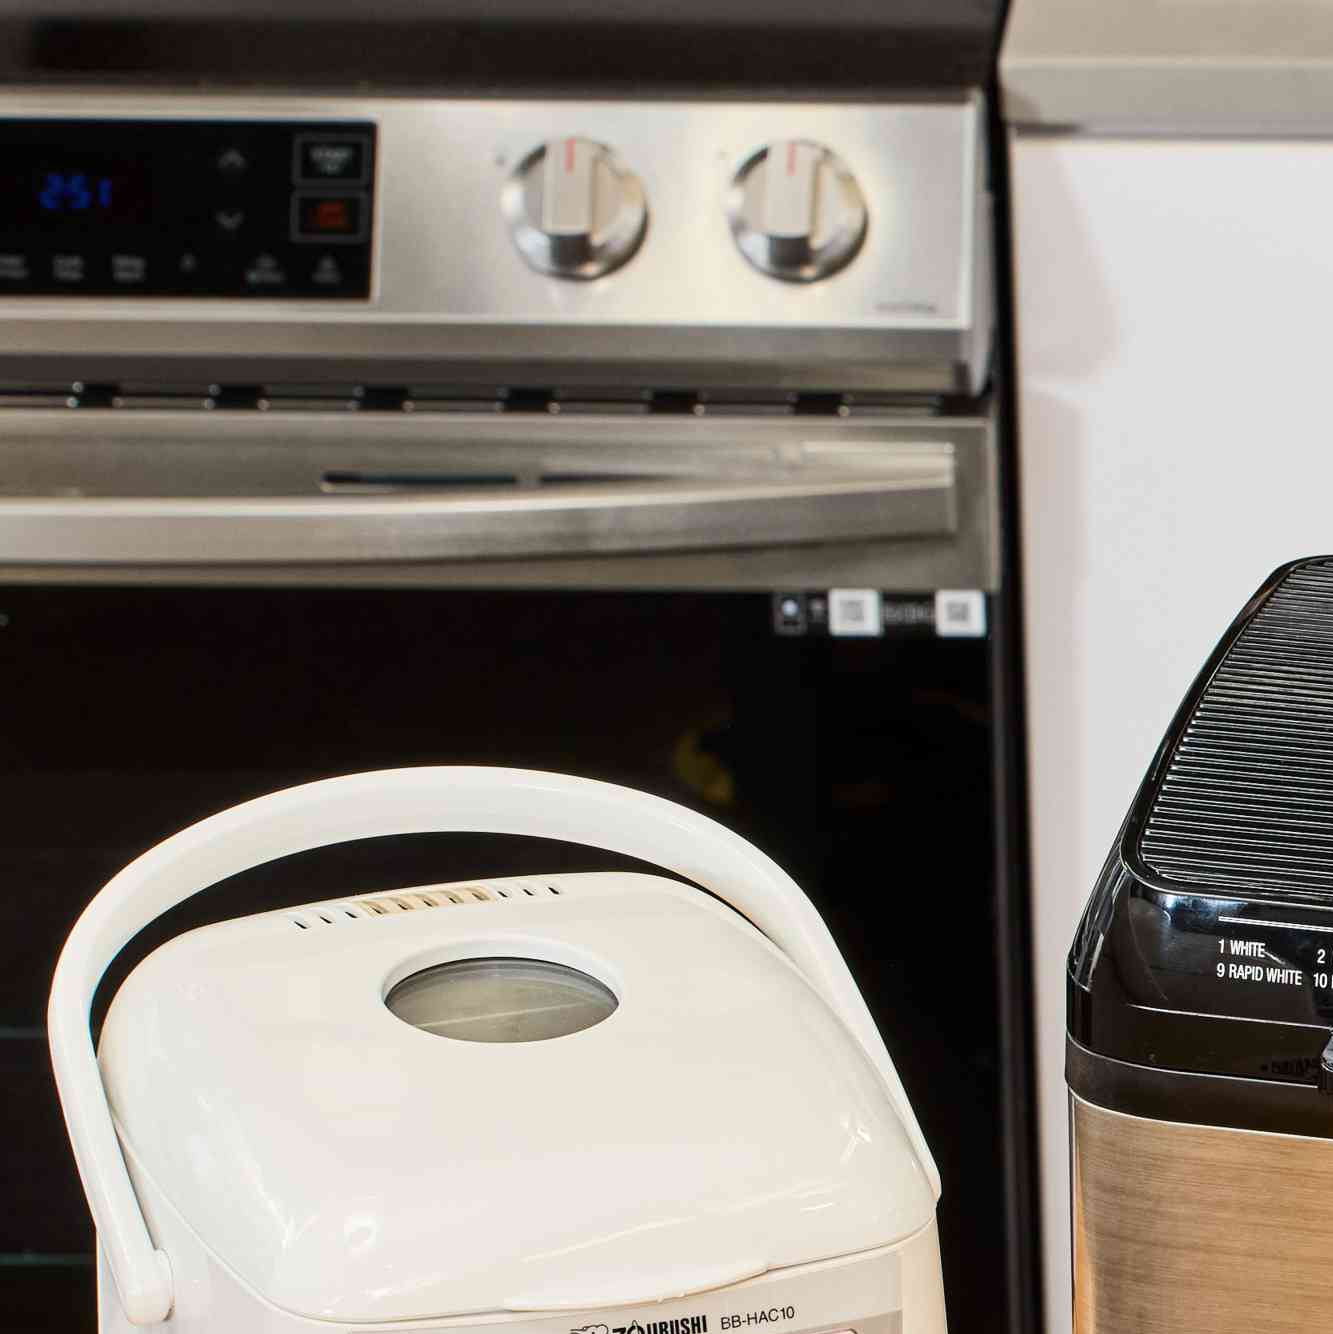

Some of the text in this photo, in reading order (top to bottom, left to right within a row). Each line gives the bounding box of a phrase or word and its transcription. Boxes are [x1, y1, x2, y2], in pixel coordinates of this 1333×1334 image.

[1218, 939, 1266, 957] 1 WHITE
[1317, 949, 1326, 964] 2
[1216, 963, 1302, 986] 9 RAPID WHITE
[1313, 973, 1328, 988] 10
[720, 1306, 795, 1330] BB-HAC10
